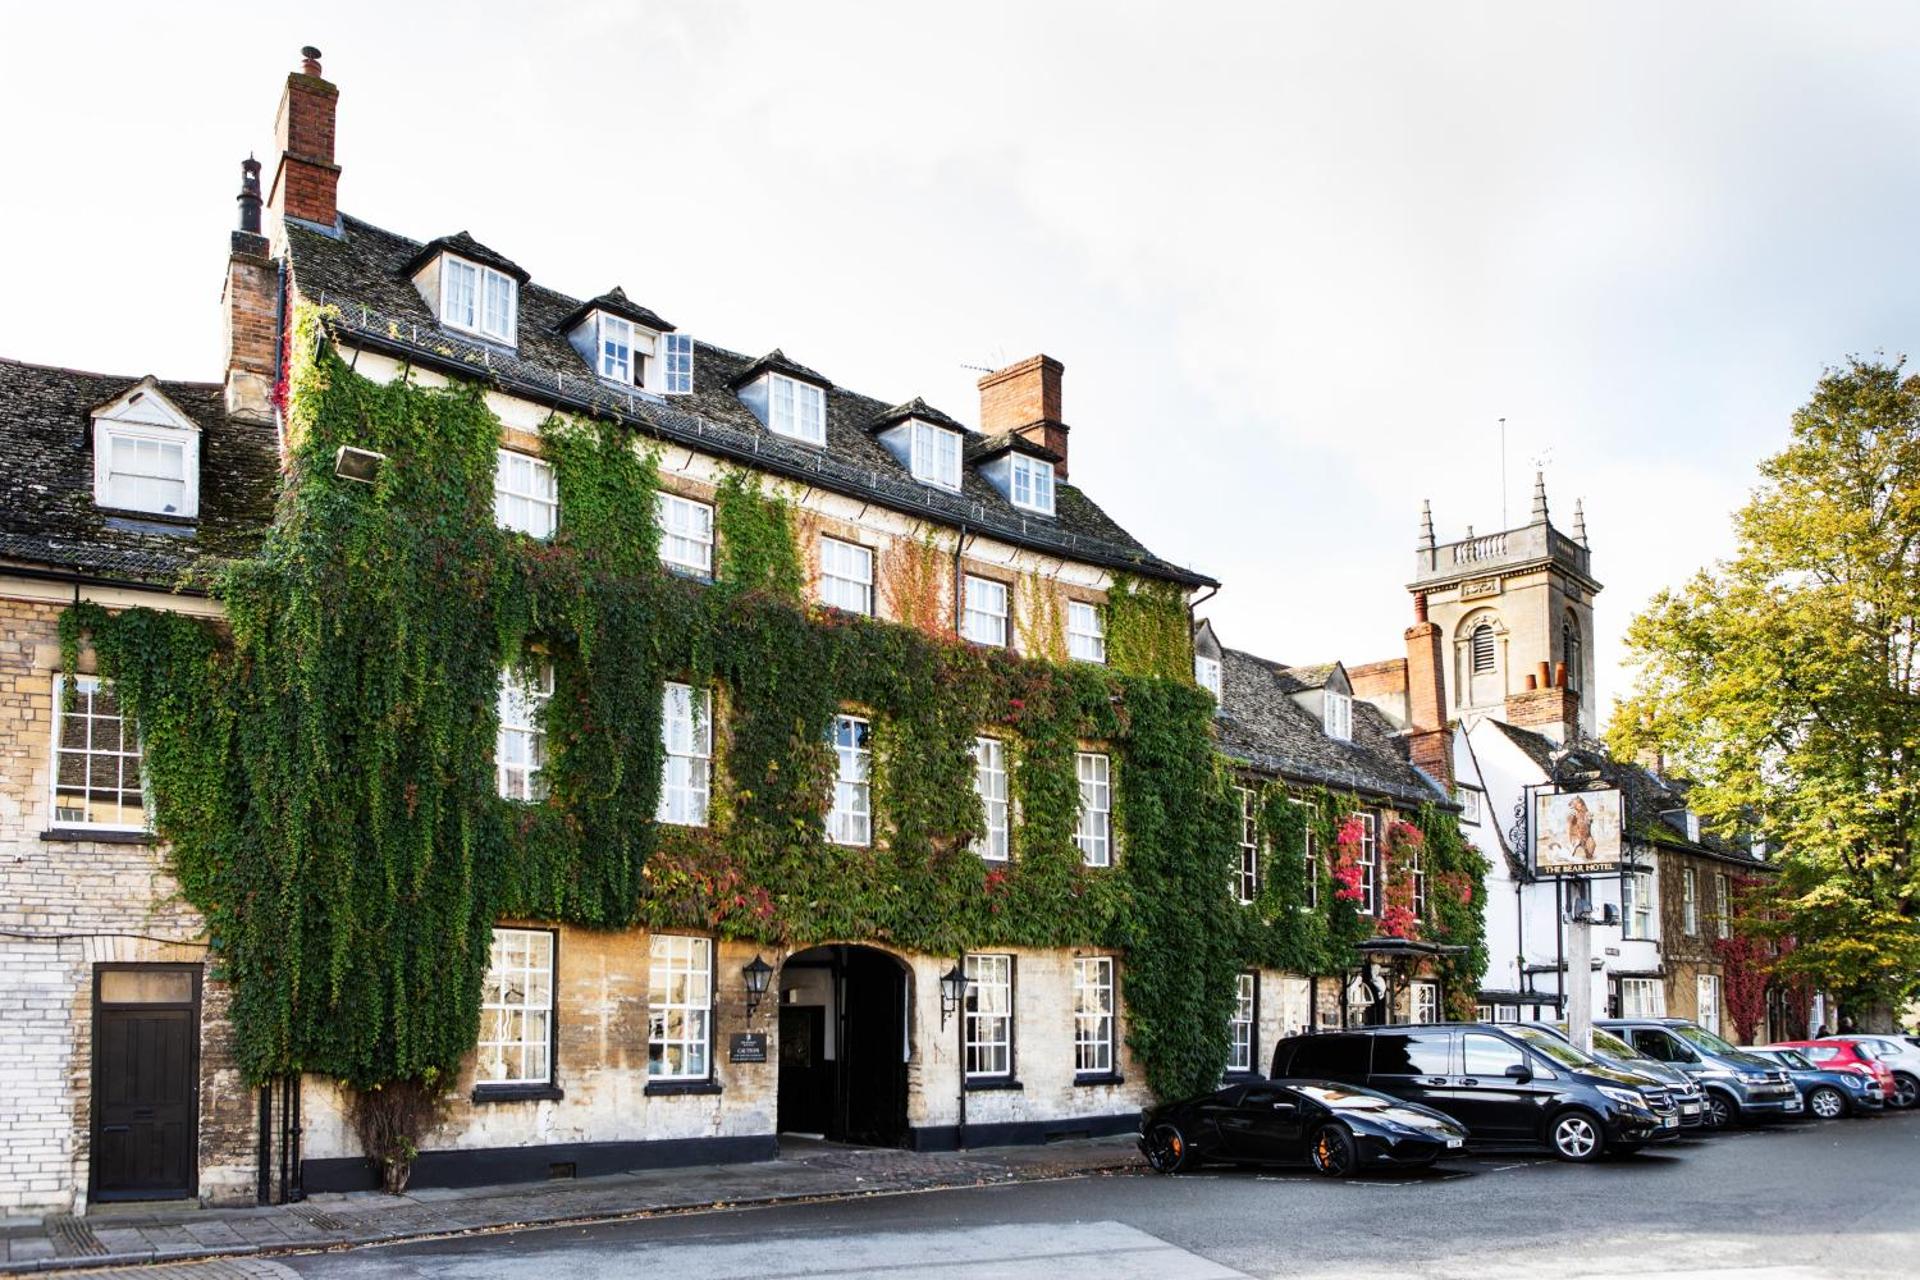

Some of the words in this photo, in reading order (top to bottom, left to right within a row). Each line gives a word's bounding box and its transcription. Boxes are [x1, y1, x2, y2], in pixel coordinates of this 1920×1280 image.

[1545, 866, 1561, 874] THE
[1562, 864, 1584, 873] BEAR
[1585, 863, 1615, 871] HOTEL
